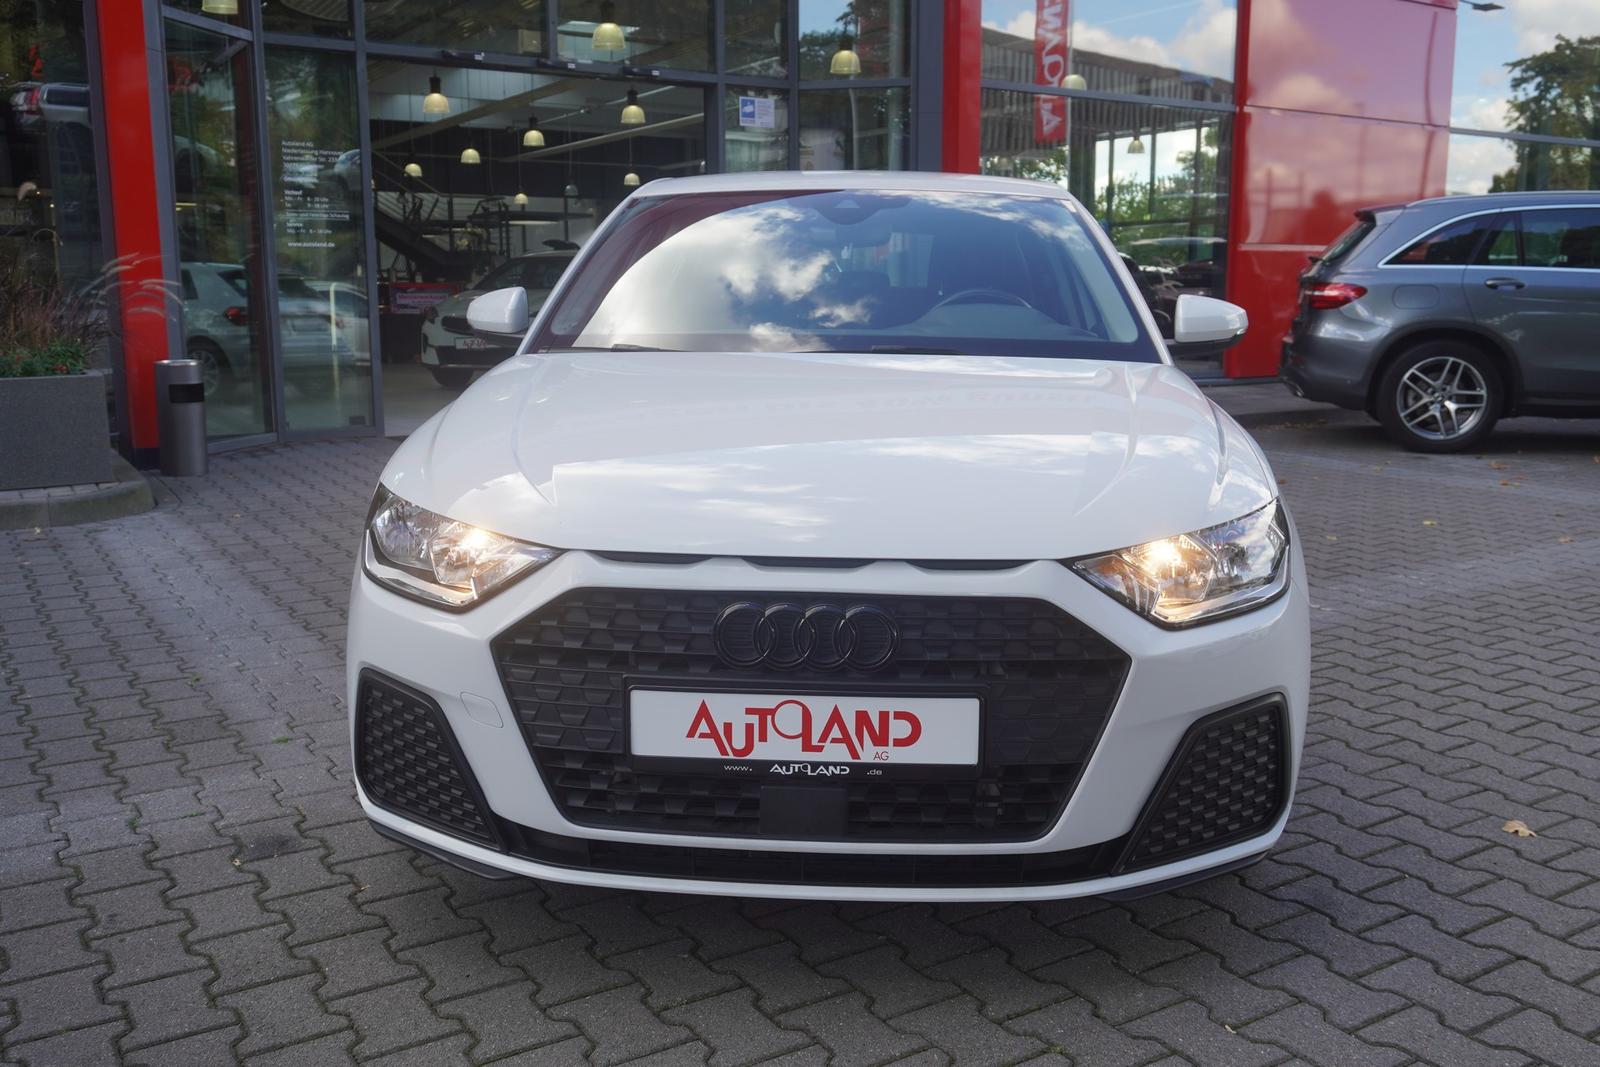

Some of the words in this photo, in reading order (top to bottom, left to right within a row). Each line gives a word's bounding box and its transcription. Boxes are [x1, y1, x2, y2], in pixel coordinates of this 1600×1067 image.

[685, 698, 922, 760] AUTOLAND
[873, 751, 889, 762] AG
[769, 762, 850, 777] AUTOLAND
